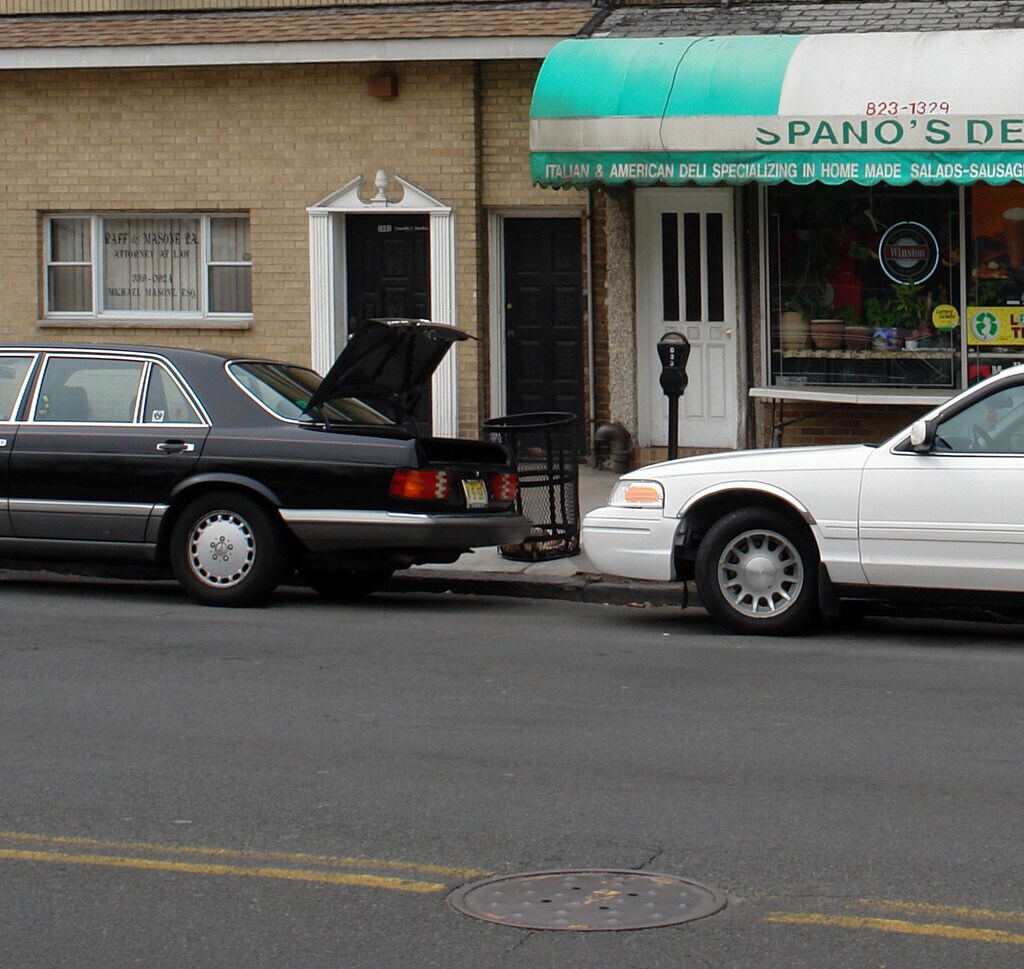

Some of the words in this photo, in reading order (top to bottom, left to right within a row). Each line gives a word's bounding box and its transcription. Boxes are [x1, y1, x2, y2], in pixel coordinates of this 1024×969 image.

[865, 101, 950, 116] 823-1329
[755, 119, 951, 145] SPANO'S
[545, 163, 590, 179] ITALIAN
[595, 164, 603, 178] &
[610, 162, 675, 179] AMERICAN
[679, 162, 707, 179] DELI
[712, 162, 798, 179] SPECIALIZING
[802, 163, 816, 178] IN
[821, 162, 859, 178] HOME
[864, 162, 902, 178] MADE
[114, 249, 154, 259] ATTORNEY
[160, 249, 169, 259] AT
[174, 249, 190, 259] LAW
[889, 247, 925, 258] Winston
[107, 287, 141, 297] MICHAEL
